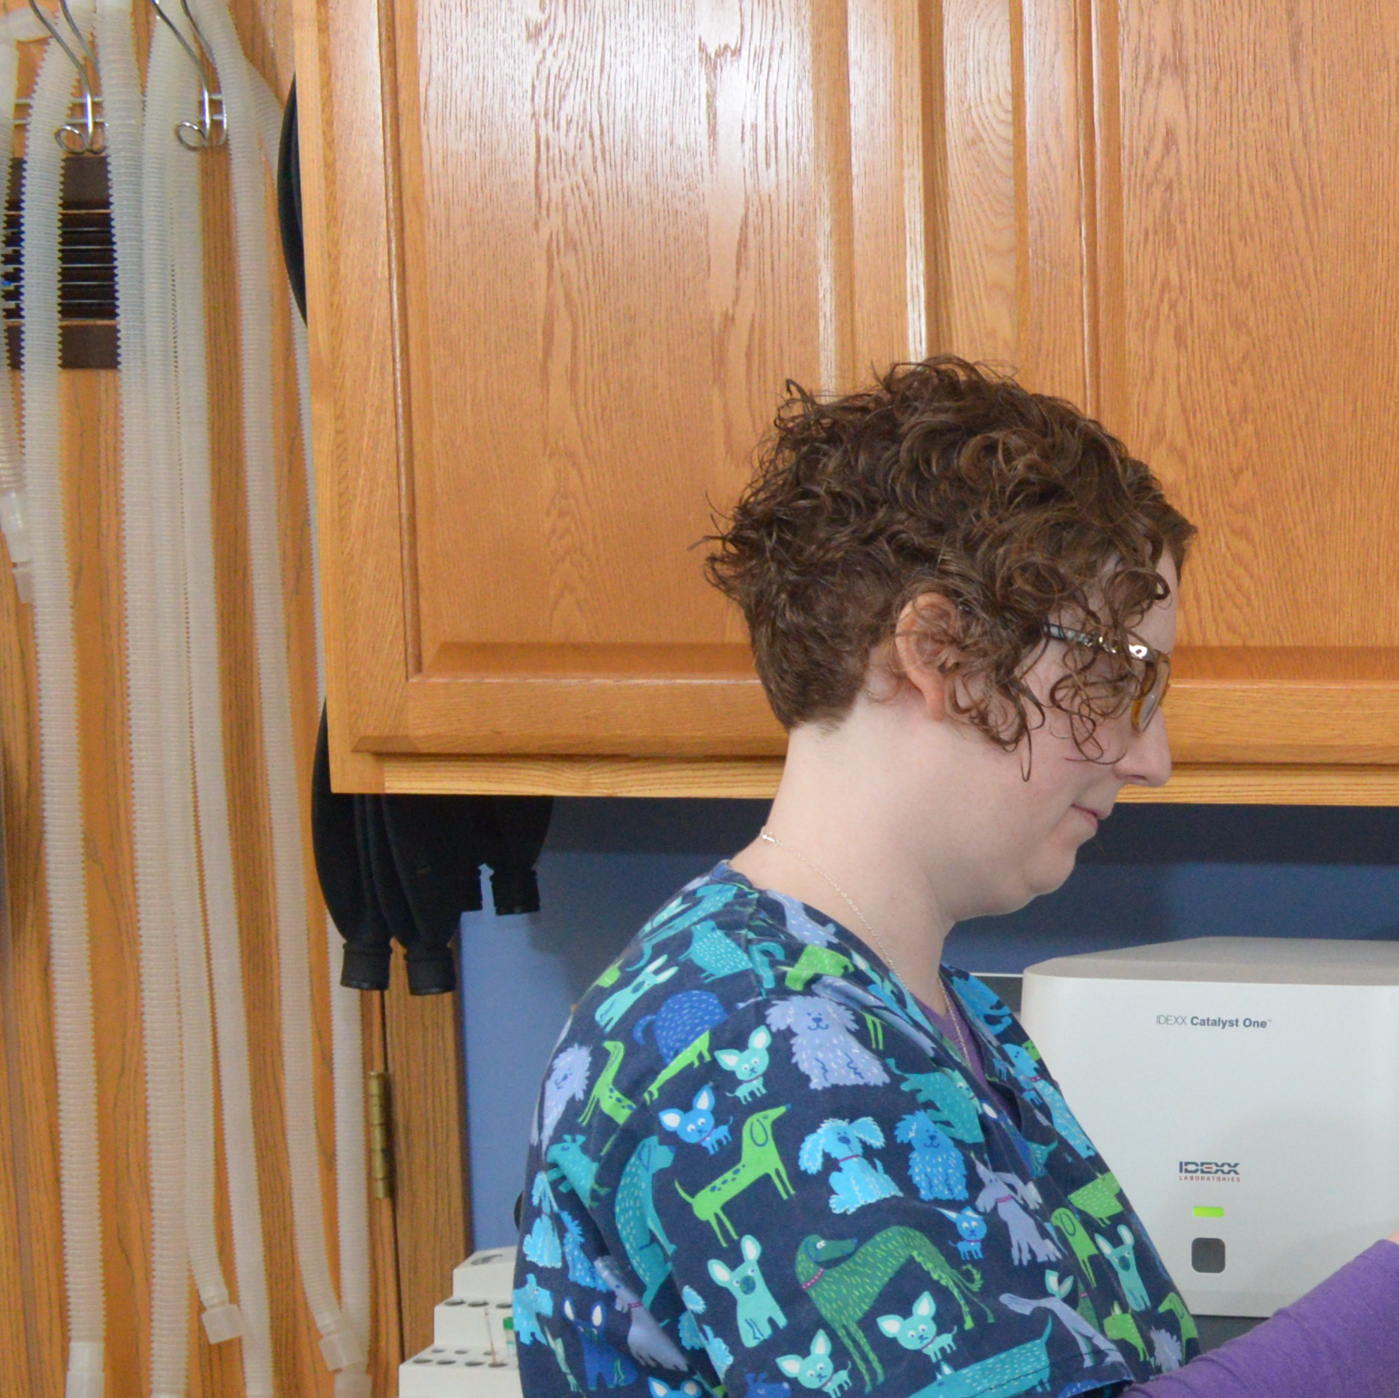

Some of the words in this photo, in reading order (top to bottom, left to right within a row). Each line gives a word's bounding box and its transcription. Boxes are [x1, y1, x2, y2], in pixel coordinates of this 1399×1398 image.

[1156, 1014, 1187, 1026] IDEXX
[1190, 1016, 1239, 1029] Catalyst
[1243, 1018, 1268, 1028] One
[1179, 1161, 1240, 1175] IDEXX
